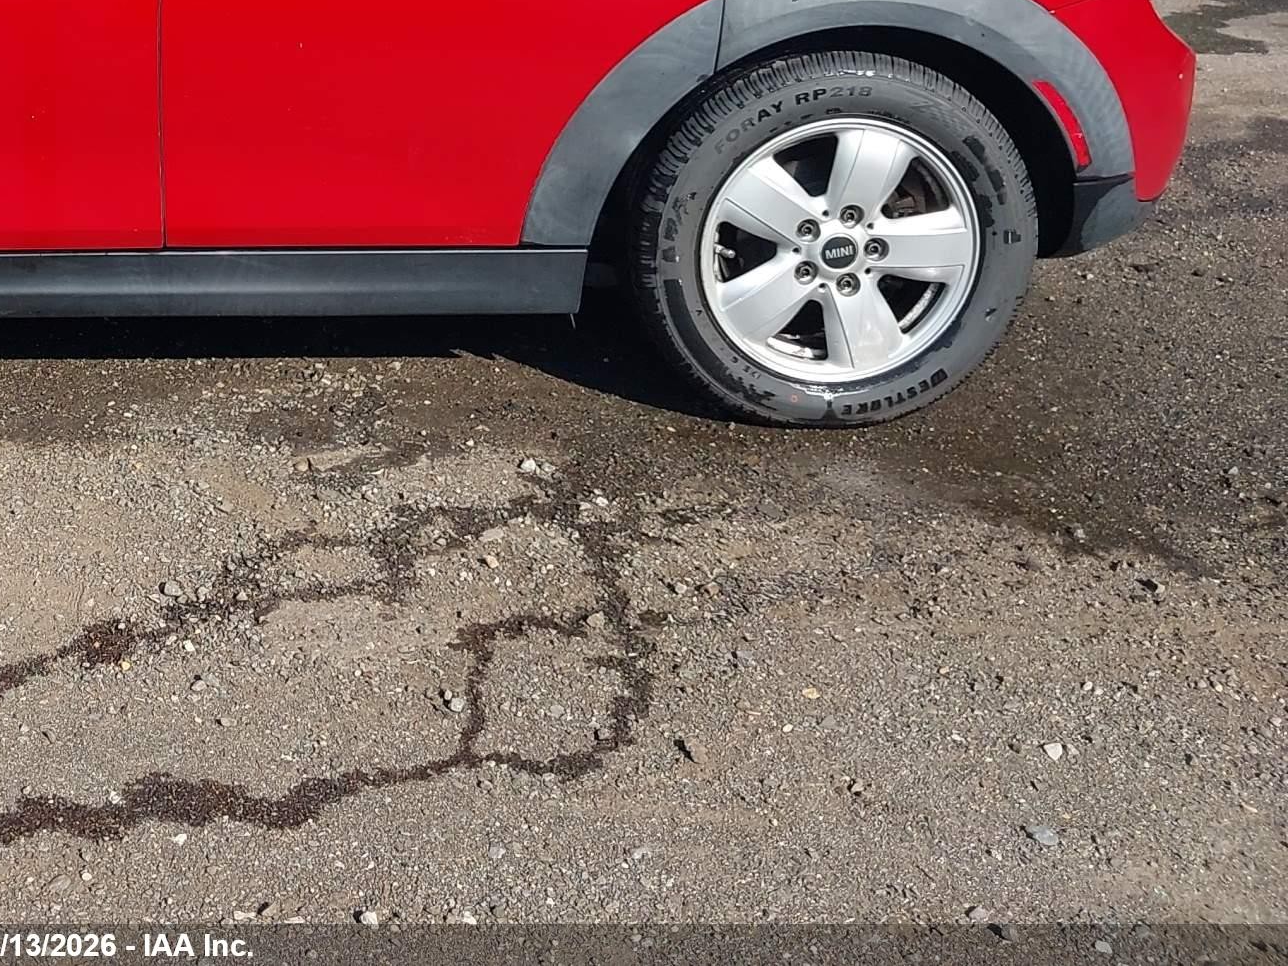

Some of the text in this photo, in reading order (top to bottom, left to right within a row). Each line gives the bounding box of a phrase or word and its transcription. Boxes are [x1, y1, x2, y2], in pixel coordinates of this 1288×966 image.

[714, 86, 873, 155] FORAY RP218
[824, 244, 854, 260] MINI
